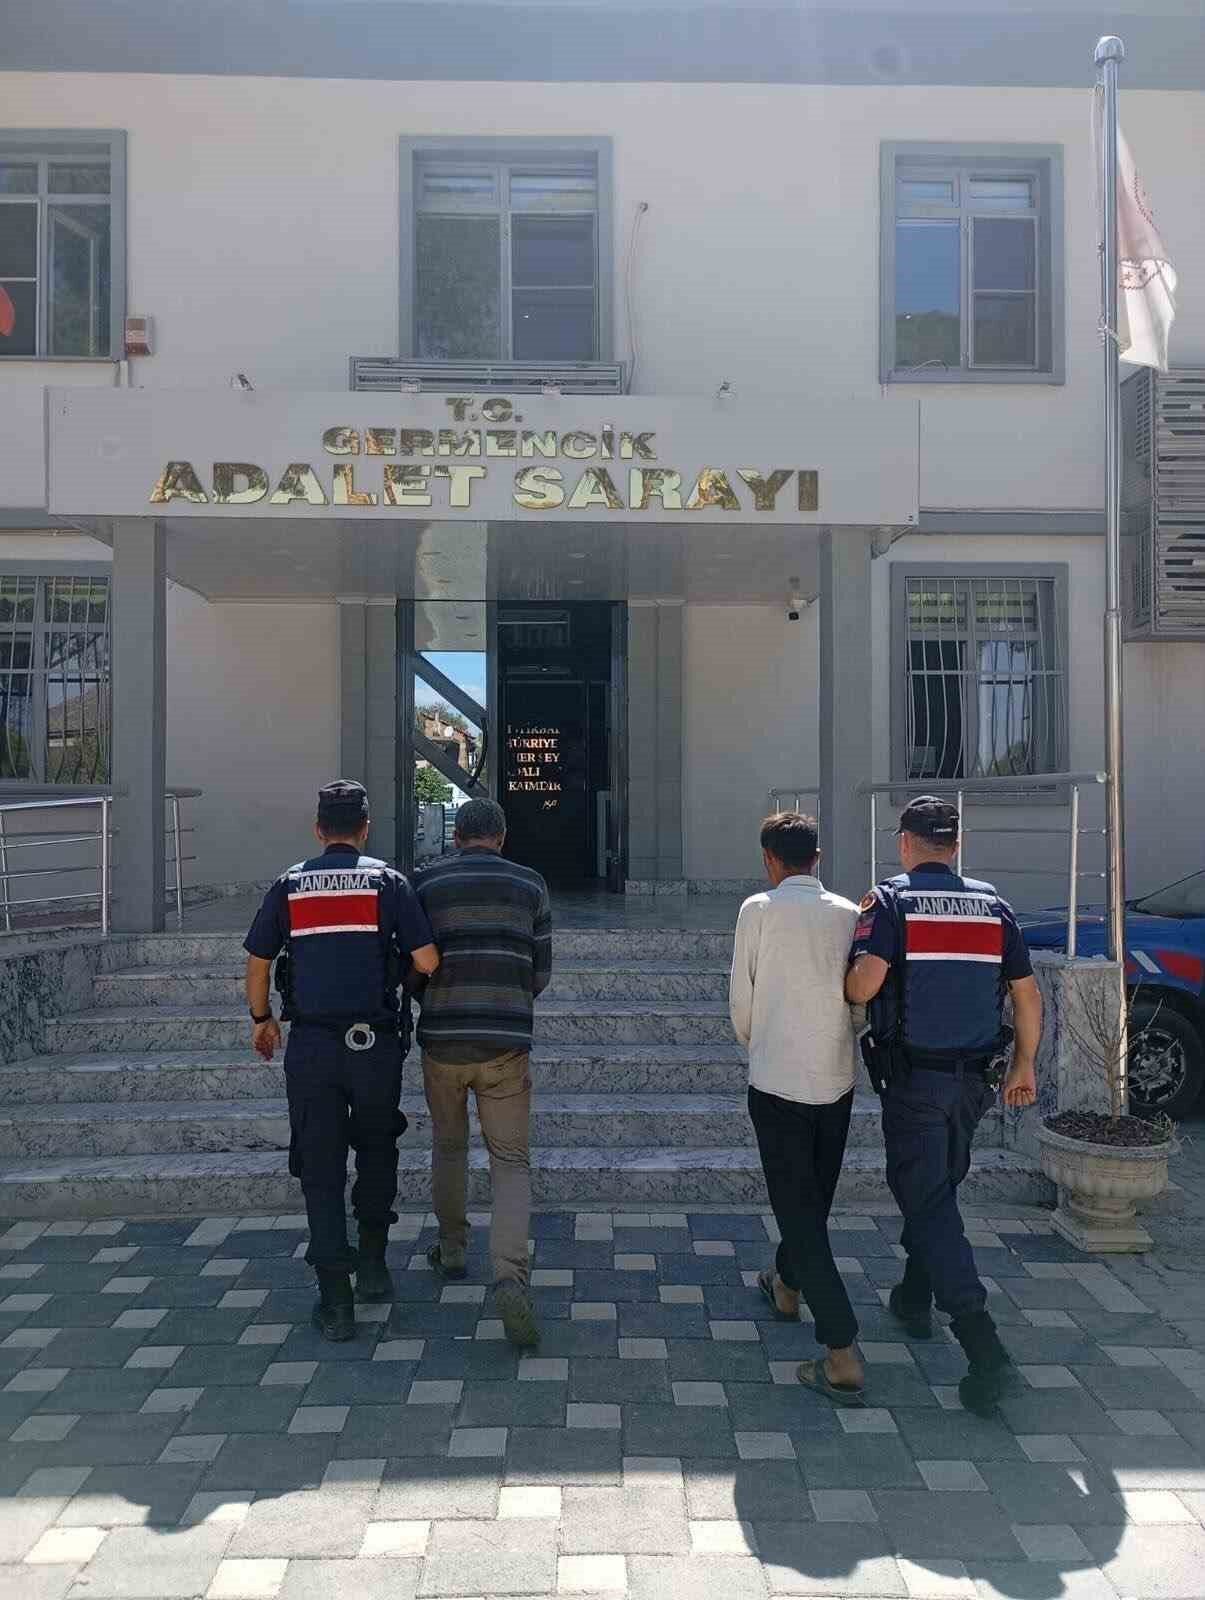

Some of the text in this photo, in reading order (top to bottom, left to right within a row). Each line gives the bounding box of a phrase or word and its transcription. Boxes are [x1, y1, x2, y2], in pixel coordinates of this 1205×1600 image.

[445, 397, 523, 423] T.C.
[321, 424, 657, 460] GERMENCİK
[149, 461, 820, 512] ADALET SARAYI
[296, 874, 370, 892] JANDARMA
[914, 897, 992, 916] JANDARMA
